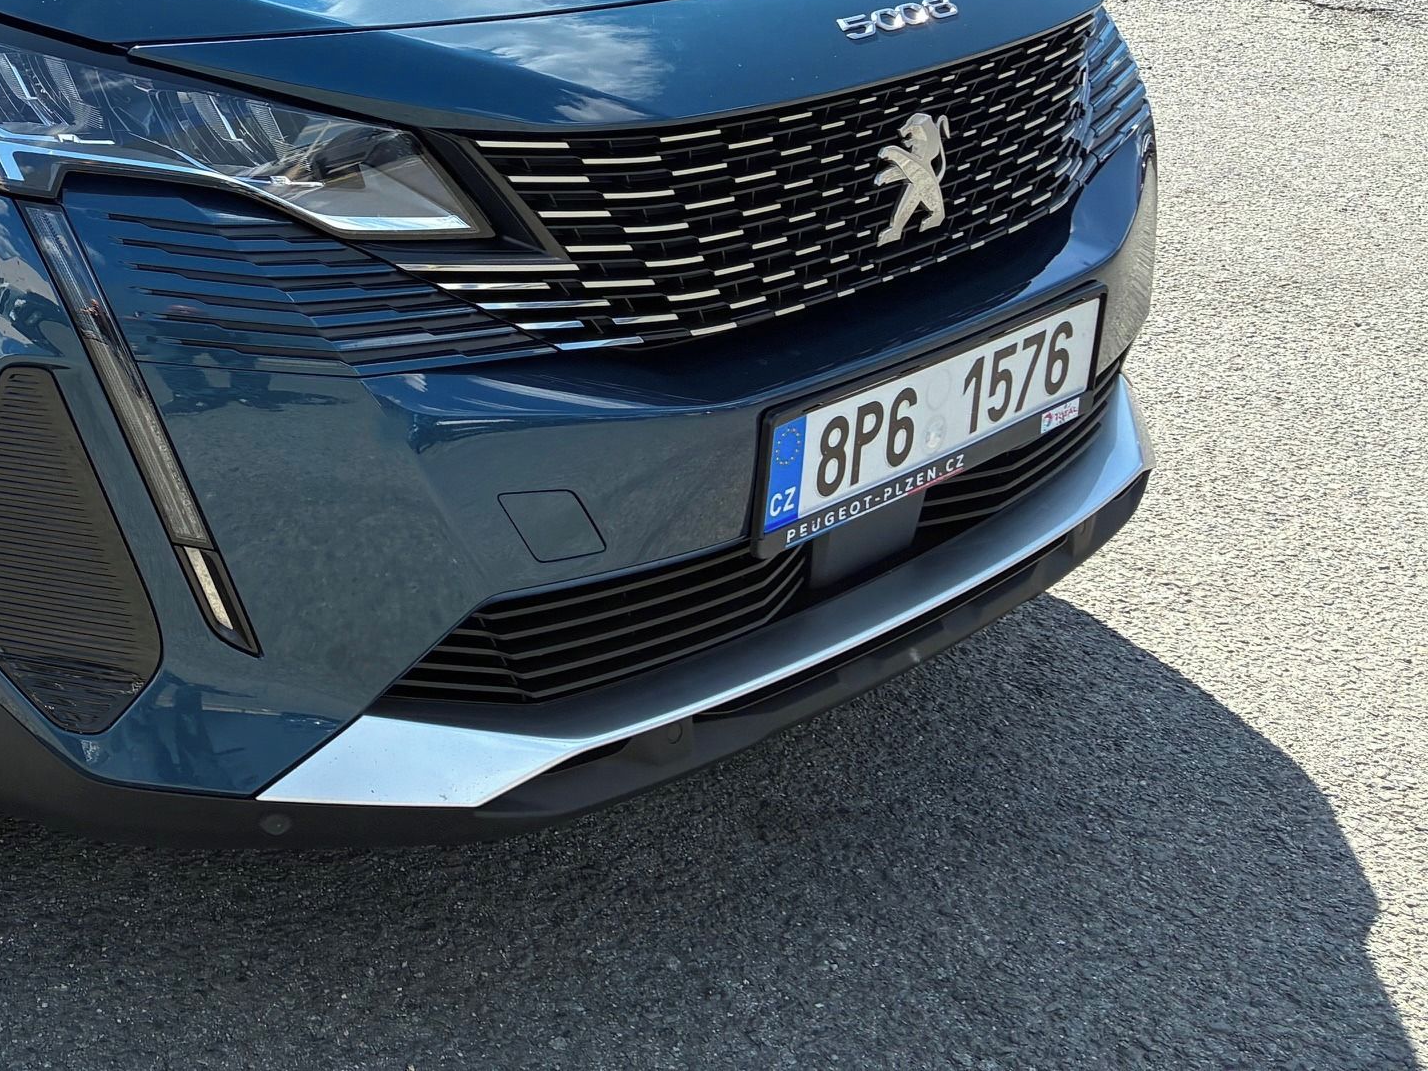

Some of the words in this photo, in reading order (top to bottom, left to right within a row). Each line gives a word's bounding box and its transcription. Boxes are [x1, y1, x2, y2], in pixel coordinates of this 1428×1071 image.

[816, 387, 918, 497] 8P6
[963, 321, 1073, 435] 1576
[769, 486, 796, 517] CZ
[786, 454, 965, 543] PEUGEOT-PLZEN.CZ
